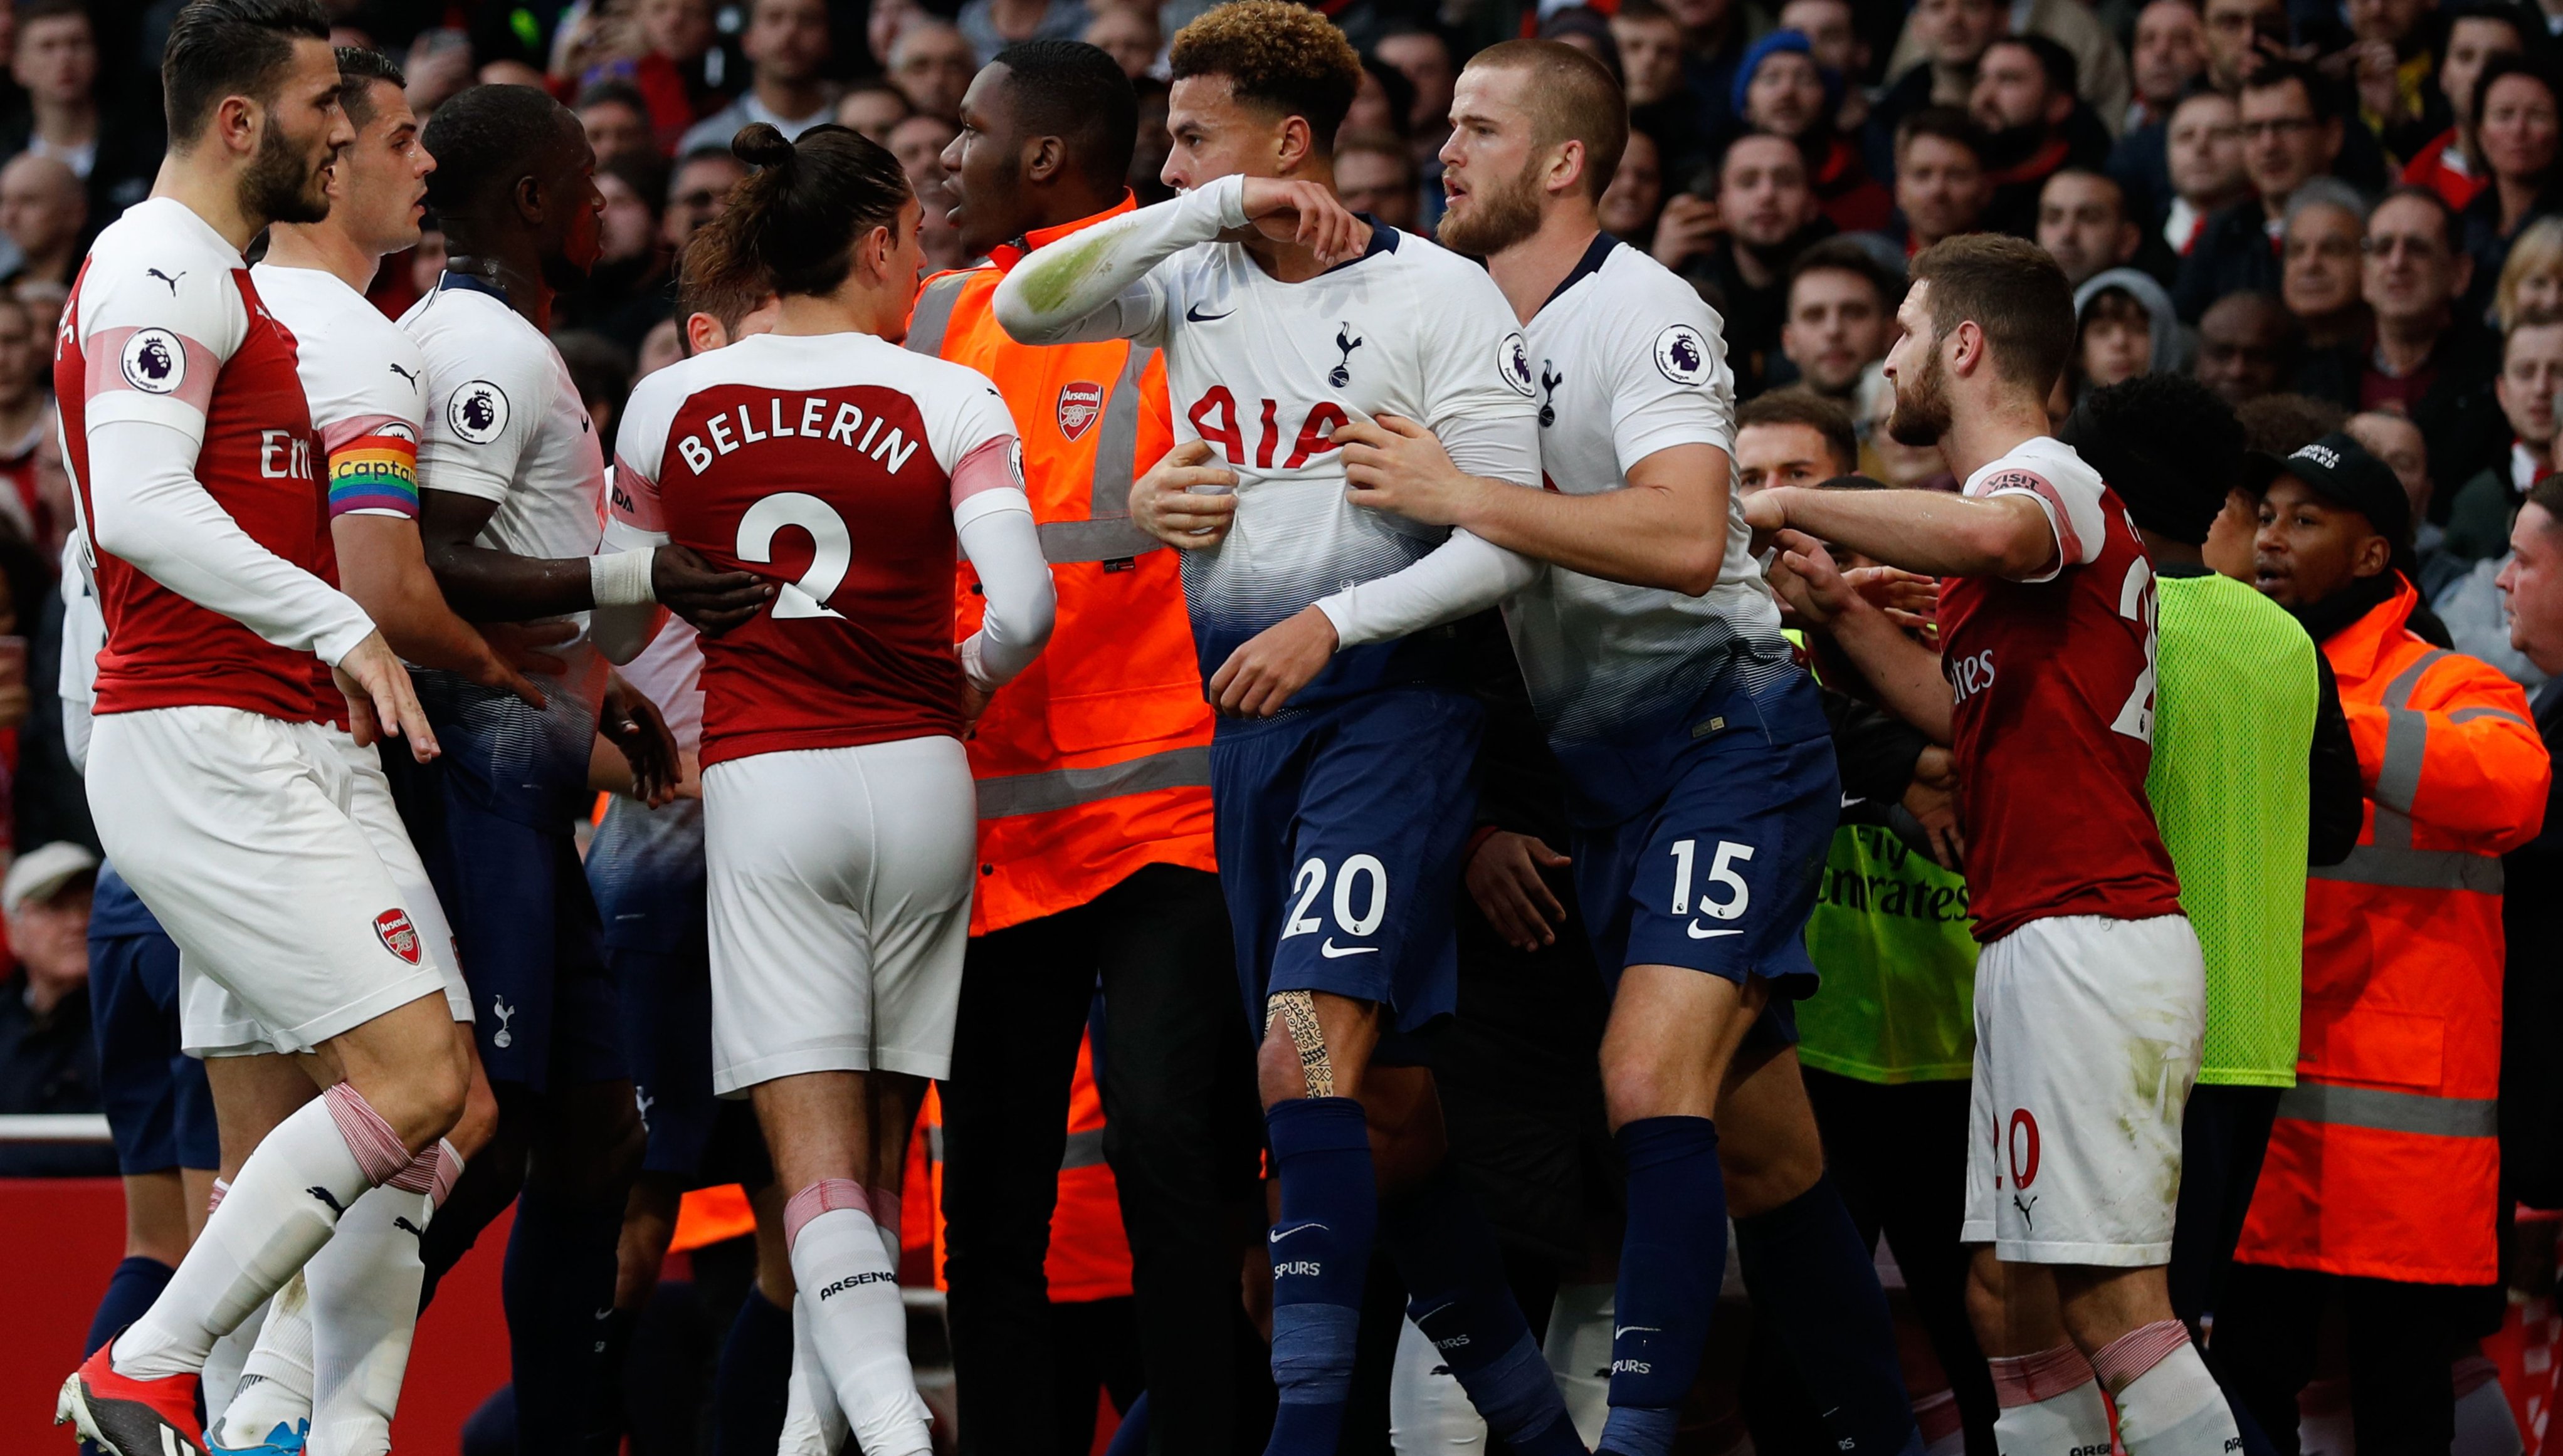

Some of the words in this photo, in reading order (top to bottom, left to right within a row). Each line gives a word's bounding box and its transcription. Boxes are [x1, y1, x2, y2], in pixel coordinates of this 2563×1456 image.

[1063, 390, 1098, 401] Arsenal
[1187, 385, 1350, 469] AIA
[677, 397, 919, 476] BELLERIN
[1987, 473, 2039, 490] VISIT
[736, 491, 851, 620] 2
[1281, 854, 1387, 940] 20
[1670, 839, 1755, 920] 15
[1993, 1108, 2040, 1190] 0
[820, 1271, 898, 1302] ARSENA
[1274, 1260, 1321, 1280] SPURS
